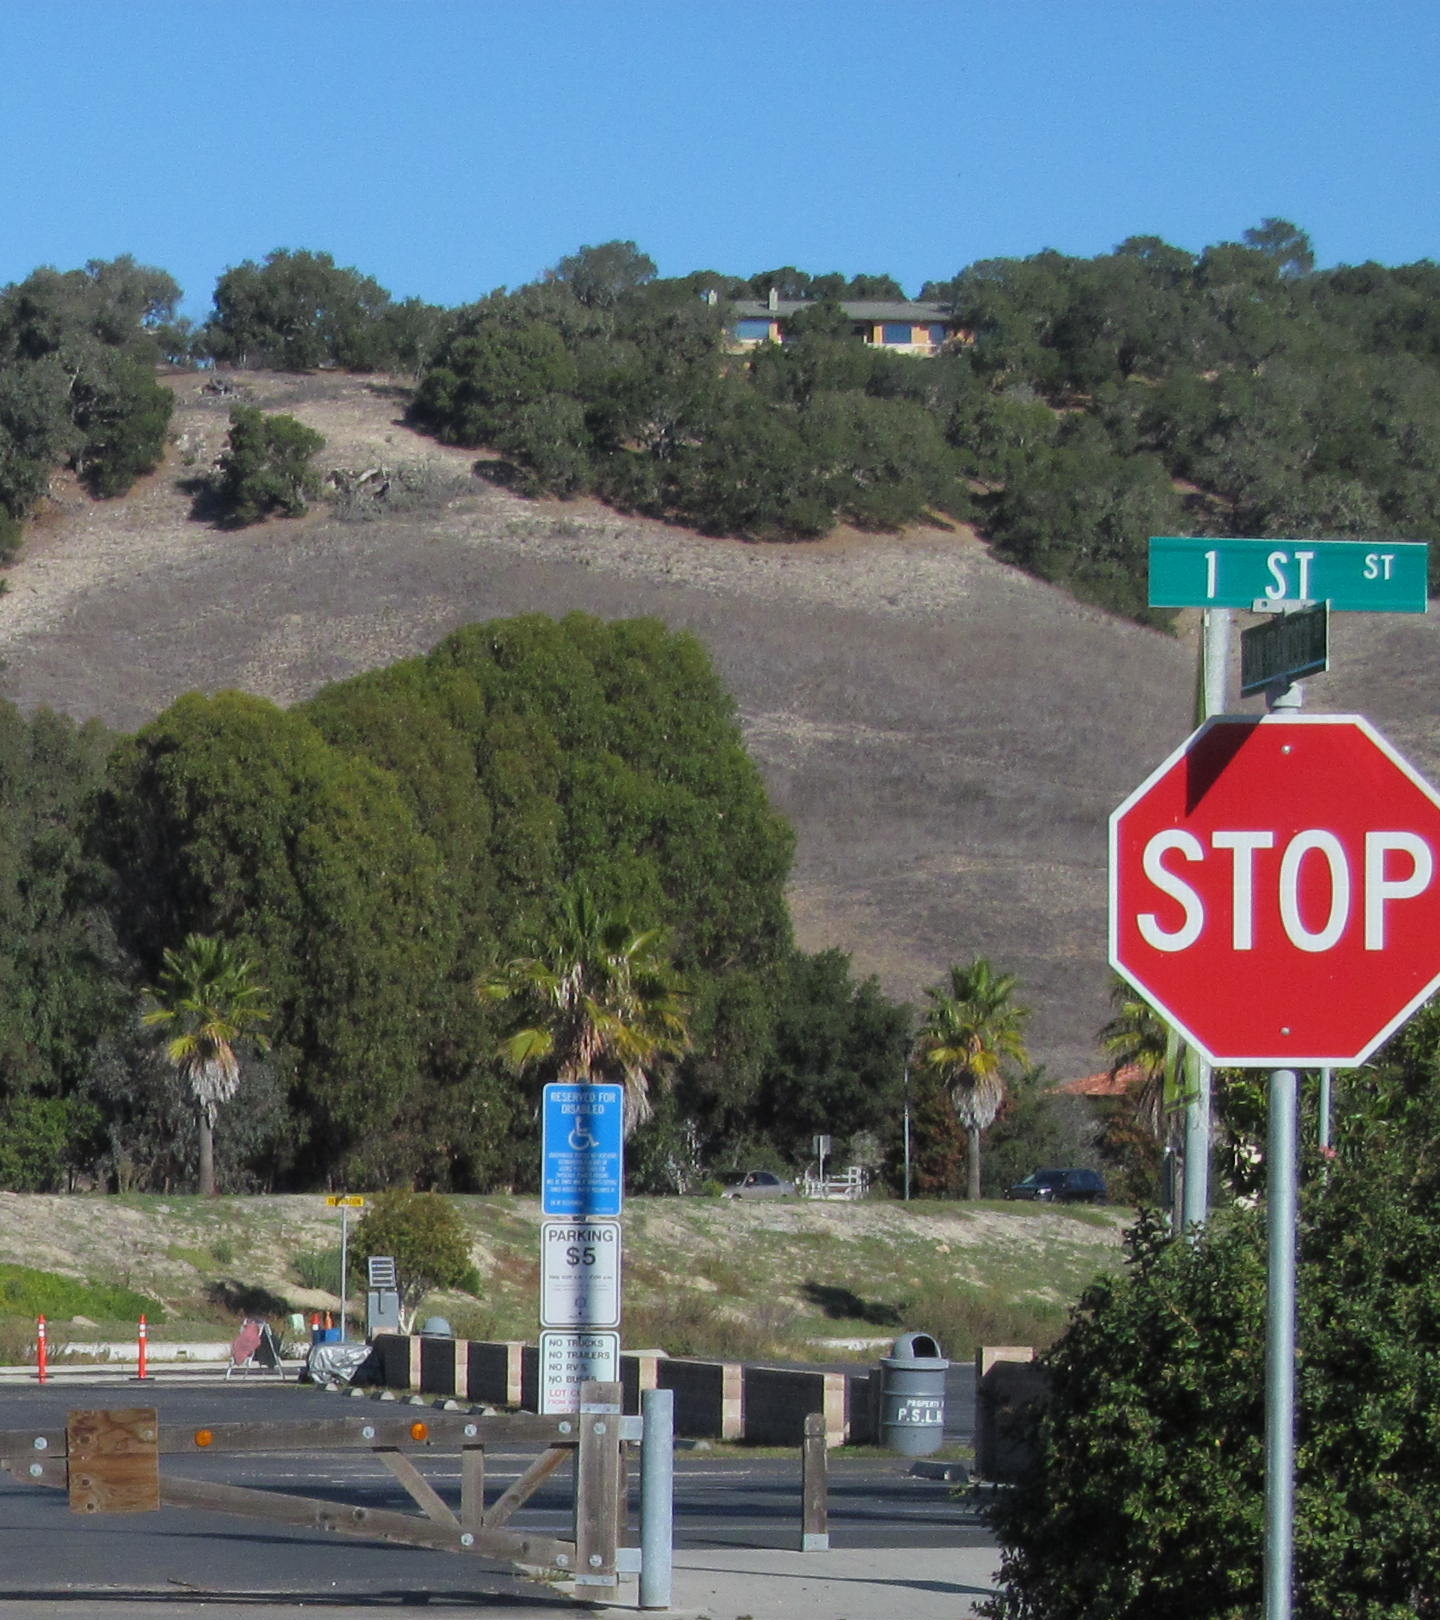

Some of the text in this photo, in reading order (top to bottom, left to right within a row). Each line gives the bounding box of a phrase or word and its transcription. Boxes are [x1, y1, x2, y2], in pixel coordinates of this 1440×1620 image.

[1203, 550, 1395, 601] 1 ST ST
[1136, 829, 1433, 953] STOP
[550, 1091, 616, 1103] RESERVED FOR
[561, 1103, 604, 1114] DISABLED
[548, 1229, 614, 1243] PARKING
[566, 1246, 596, 1268] $5
[548, 1338, 604, 1348] NO TRUCKS
[548, 1351, 610, 1360] NO TRAILERS
[548, 1363, 562, 1372] NO
[548, 1375, 562, 1385] NO
[549, 1389, 566, 1398] LOT
